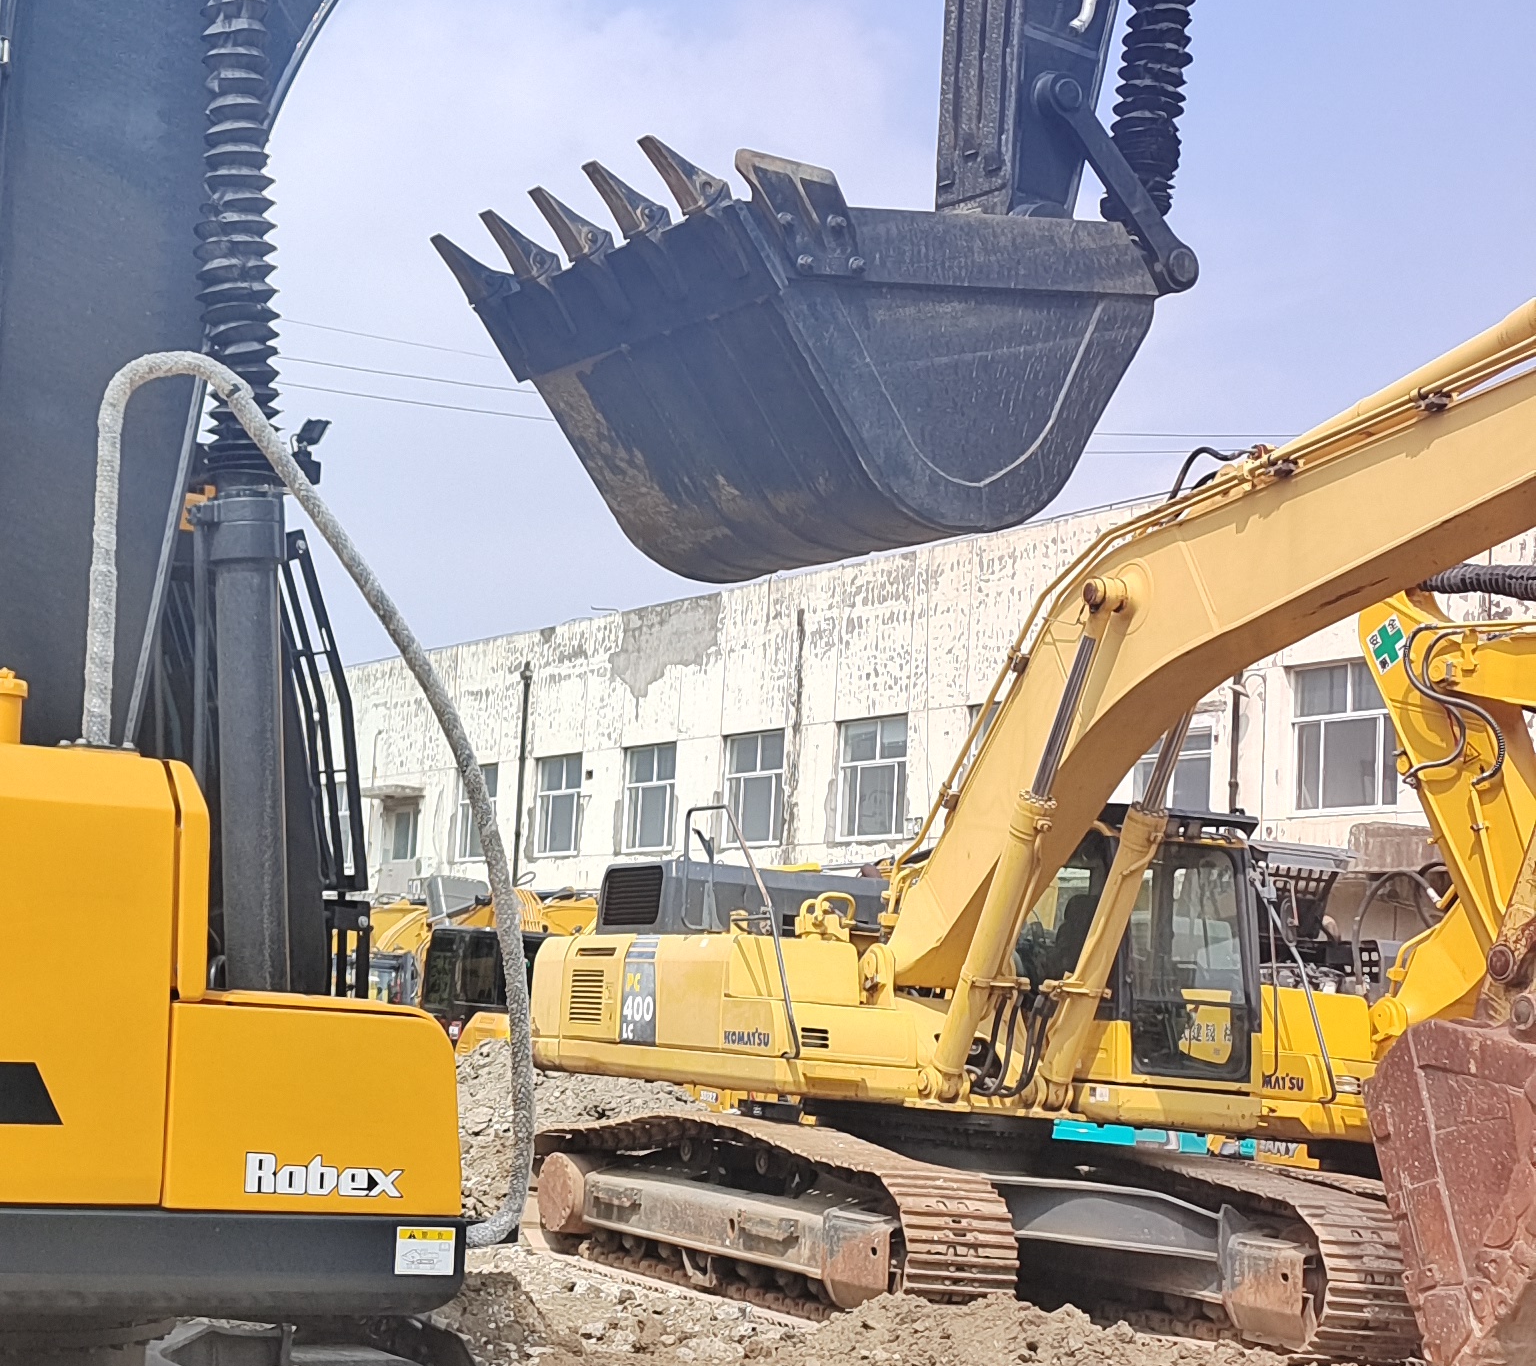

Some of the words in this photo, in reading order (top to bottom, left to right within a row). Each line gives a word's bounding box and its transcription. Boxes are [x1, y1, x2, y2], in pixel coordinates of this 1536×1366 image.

[625, 972, 641, 992] PC
[622, 995, 654, 1022] 400
[622, 1022, 634, 1040] LC
[723, 1026, 770, 1048] KOMATSU
[1262, 1072, 1304, 1092] MATSU
[244, 1151, 405, 1198] Robex
